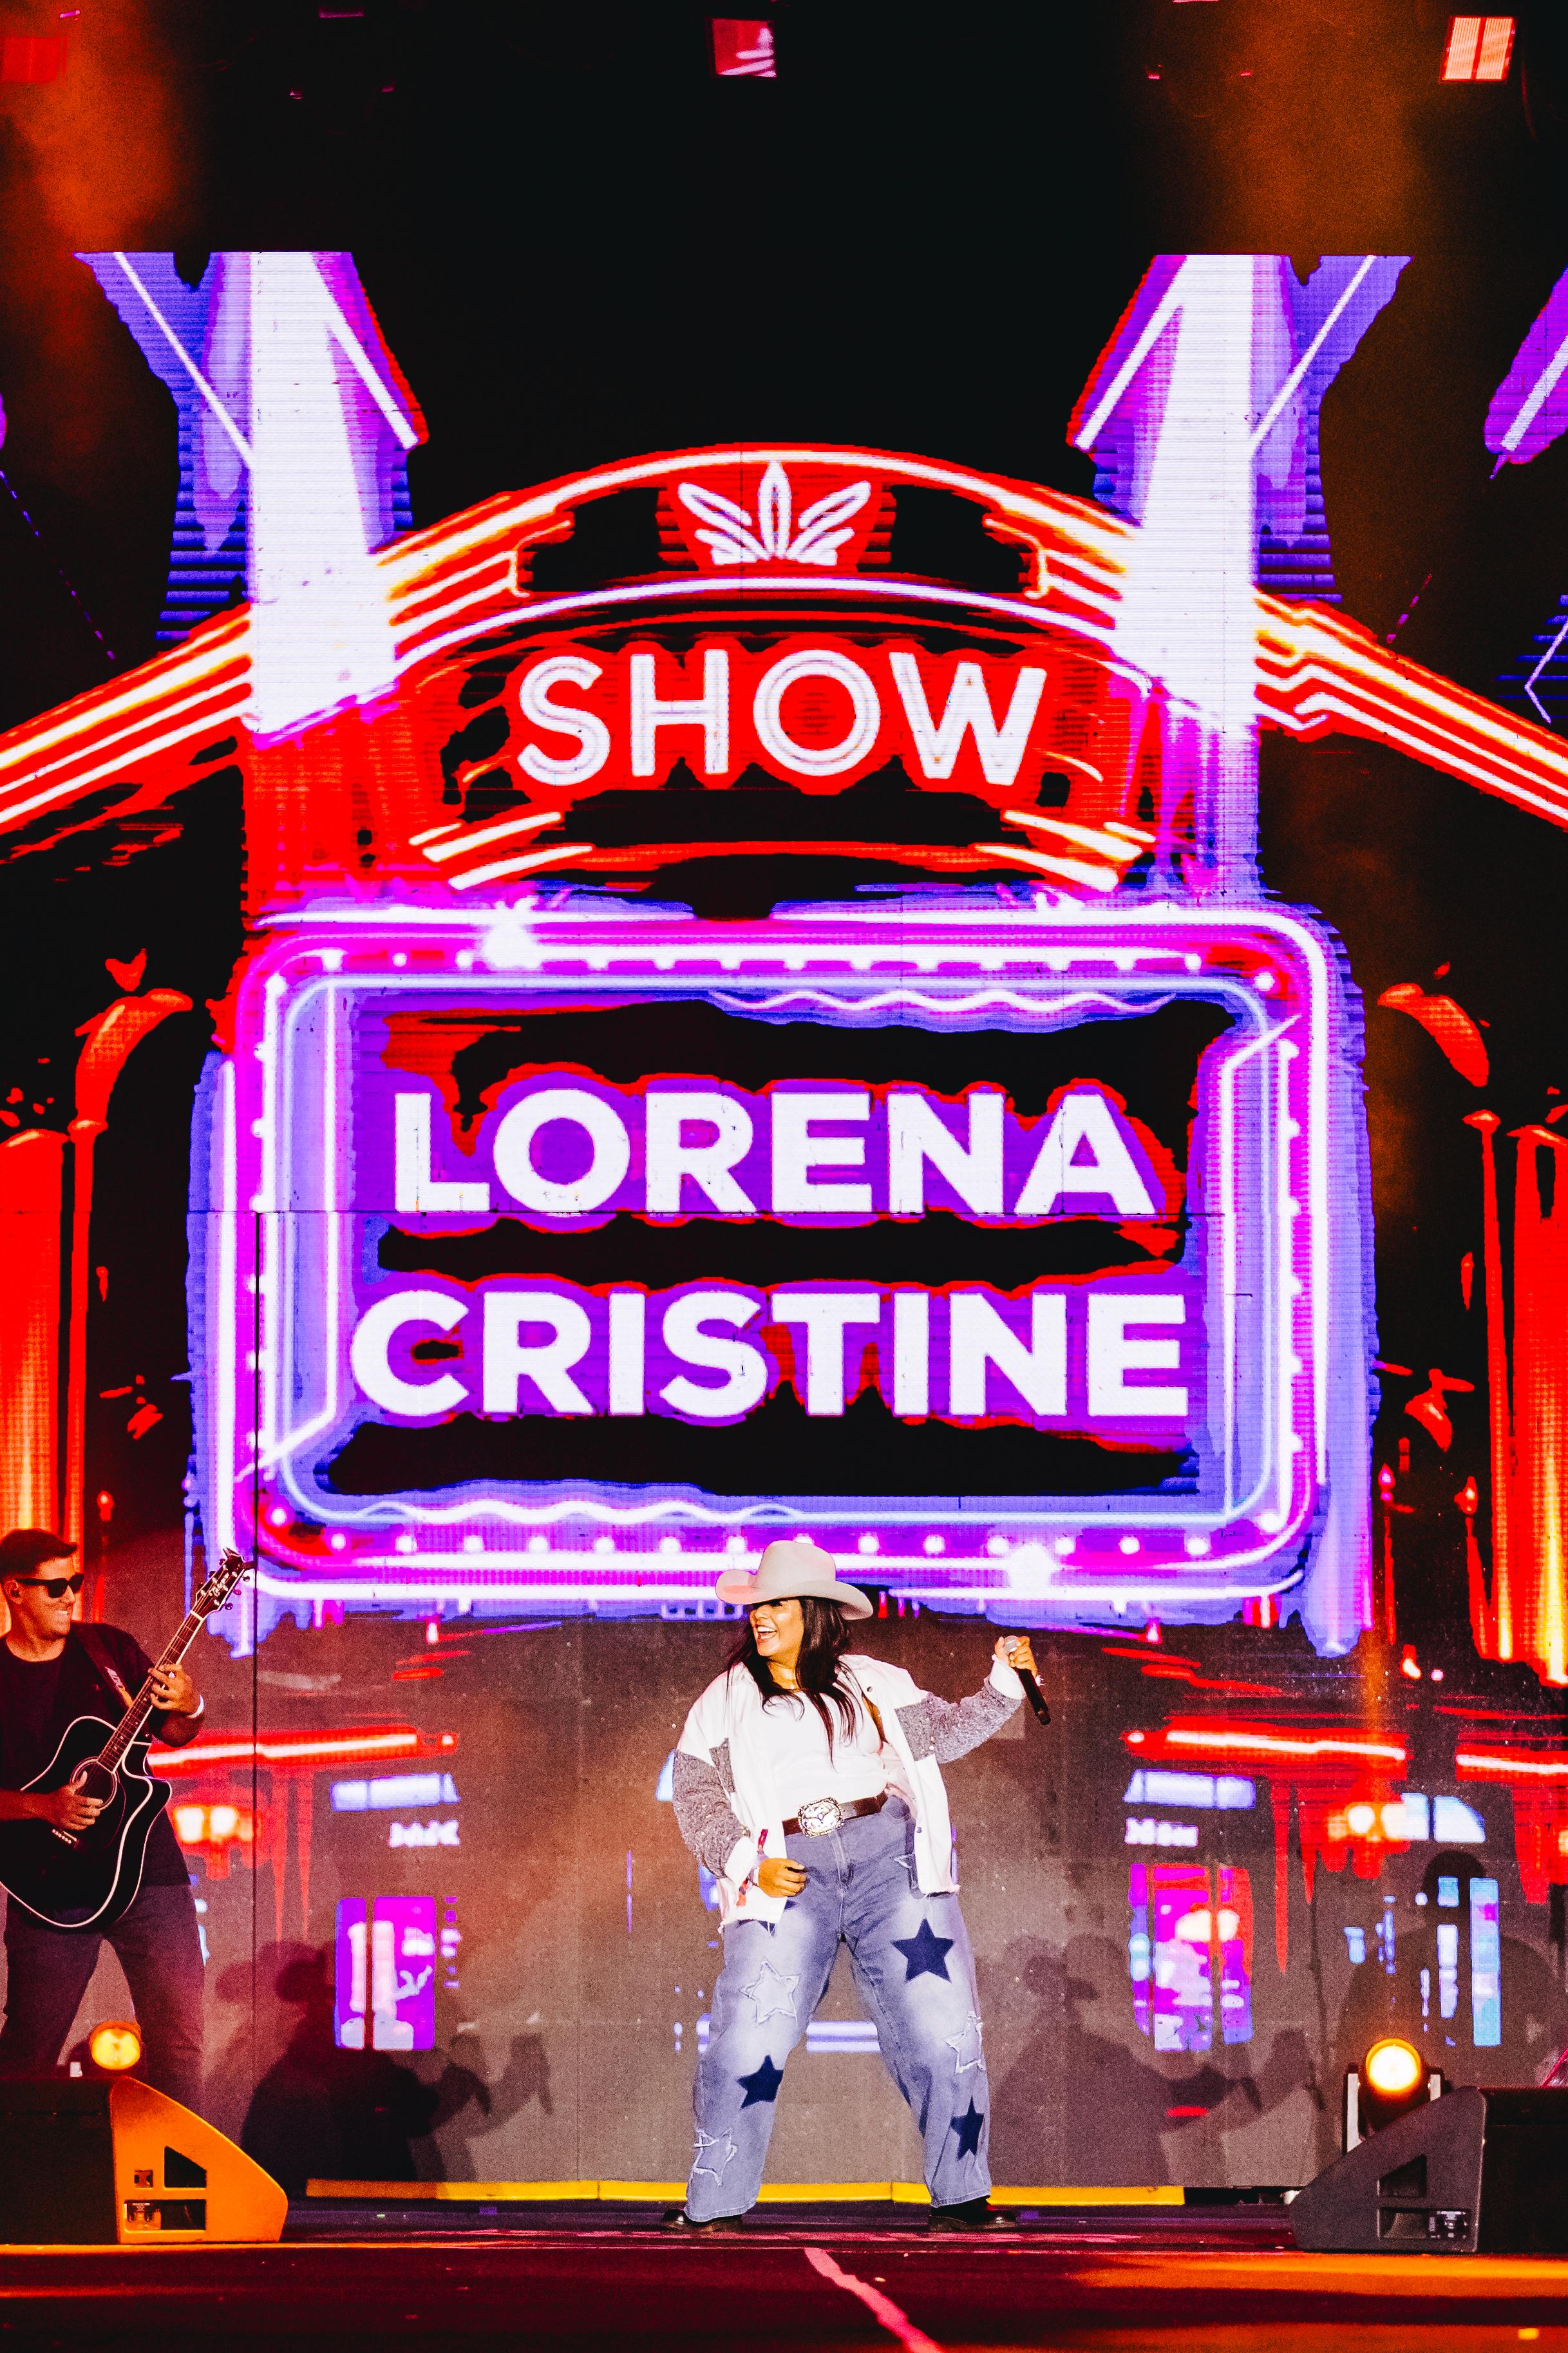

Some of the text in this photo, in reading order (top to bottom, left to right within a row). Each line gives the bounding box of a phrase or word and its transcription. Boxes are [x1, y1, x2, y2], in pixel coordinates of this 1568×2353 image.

[517, 648, 1047, 786] SHOW
[395, 1089, 1157, 1217] LORENA
[350, 1290, 1189, 1418] CRISTINE
